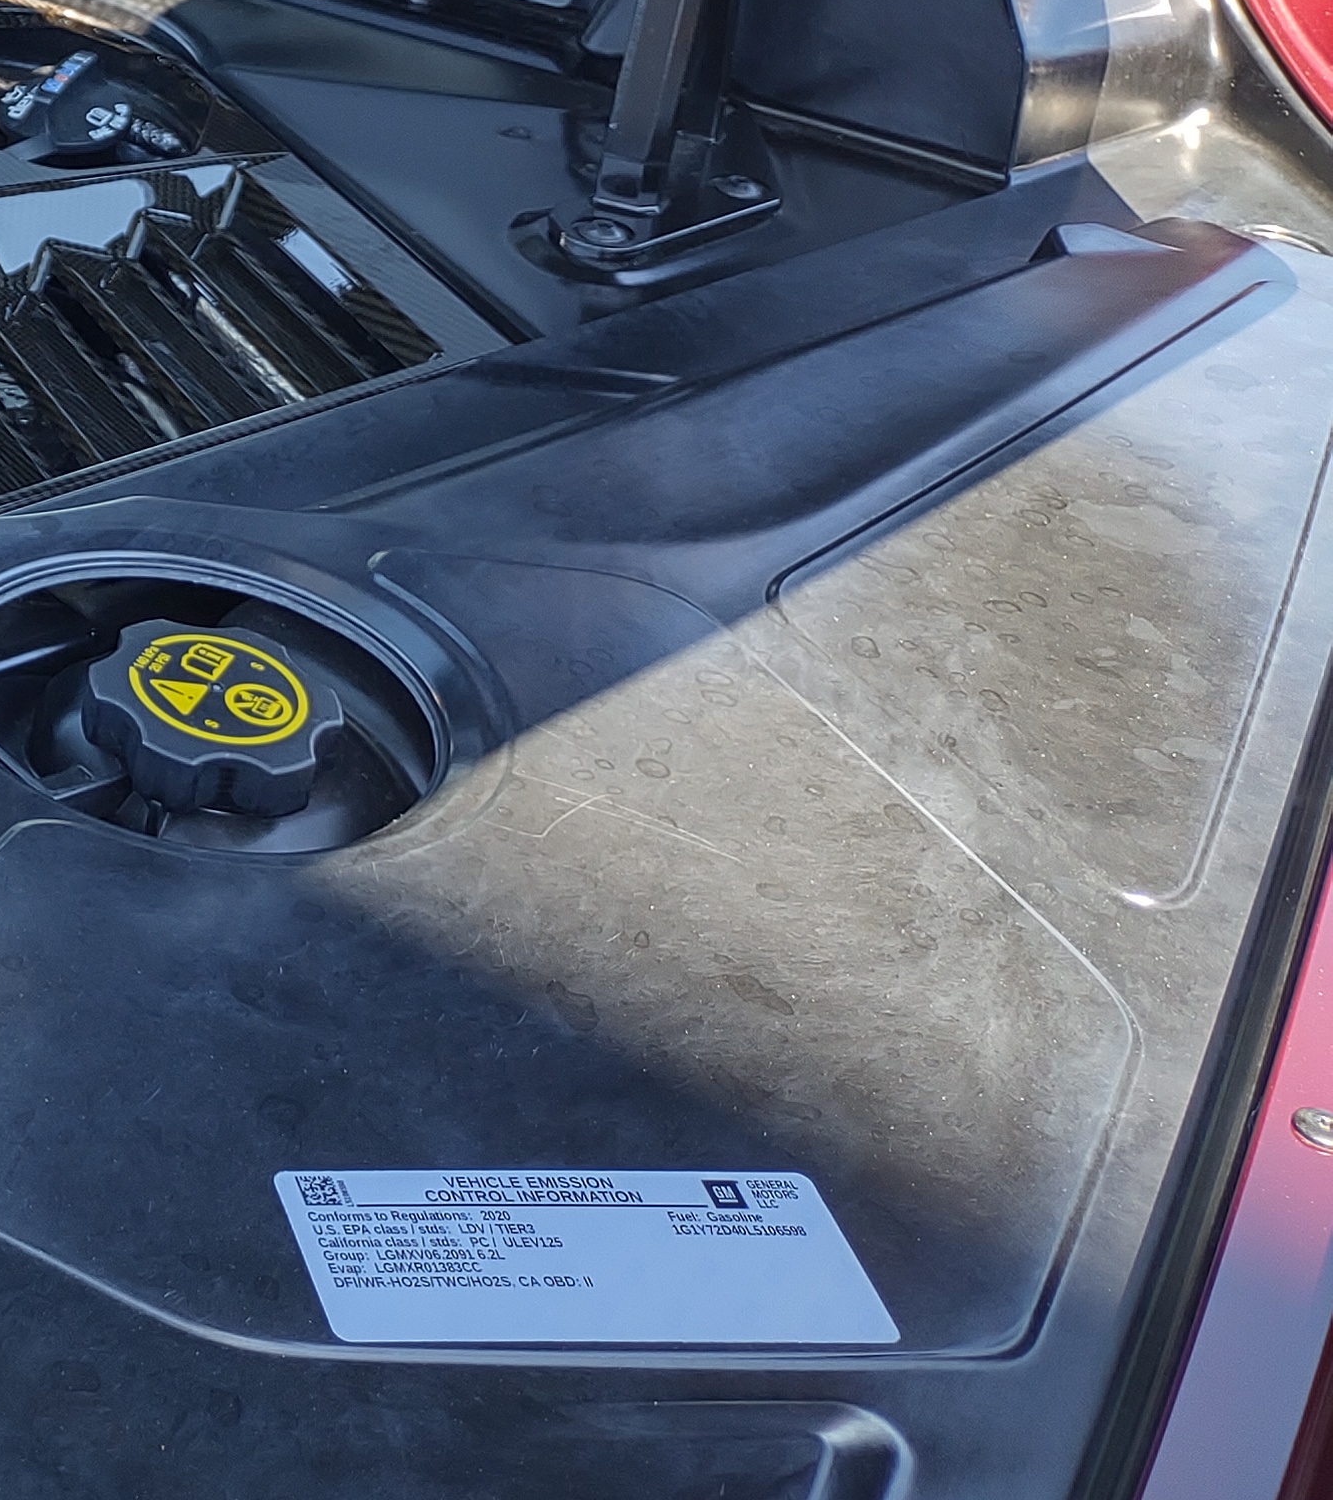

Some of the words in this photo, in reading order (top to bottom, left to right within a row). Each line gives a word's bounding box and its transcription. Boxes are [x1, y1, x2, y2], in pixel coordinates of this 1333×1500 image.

[443, 1176, 522, 1188] VEHICLE
[526, 1177, 614, 1189] EMISSION
[746, 1179, 799, 1190] GENERAL
[424, 1189, 515, 1202] CONTROL
[517, 1190, 643, 1203] INFORMATION
[751, 1190, 799, 1200] MOTORS
[756, 1199, 779, 1209] LLC
[308, 1211, 372, 1222] Conforms
[374, 1212, 387, 1222] to
[391, 1211, 473, 1223] Regulations:
[480, 1211, 510, 1221] 2020
[667, 1211, 701, 1222] Fuel:
[706, 1211, 764, 1223] Gasoline
[313, 1224, 339, 1235] U.S.
[343, 1224, 371, 1235] EPA
[373, 1224, 408, 1235] class
[419, 1224, 451, 1235] stds:
[458, 1224, 486, 1235] LDV
[497, 1224, 536, 1235] TIER3
[318, 1237, 383, 1248] California
[384, 1237, 419, 1248] class
[429, 1237, 462, 1248] stds:
[470, 1237, 490, 1248] PC
[502, 1237, 563, 1248] ULEV125
[323, 1249, 370, 1262] Group:
[477, 1249, 506, 1261] 6.2L
[329, 1263, 367, 1276] Evap:
[518, 1277, 542, 1288] CA
[545, 1277, 582, 1288] OBD:
